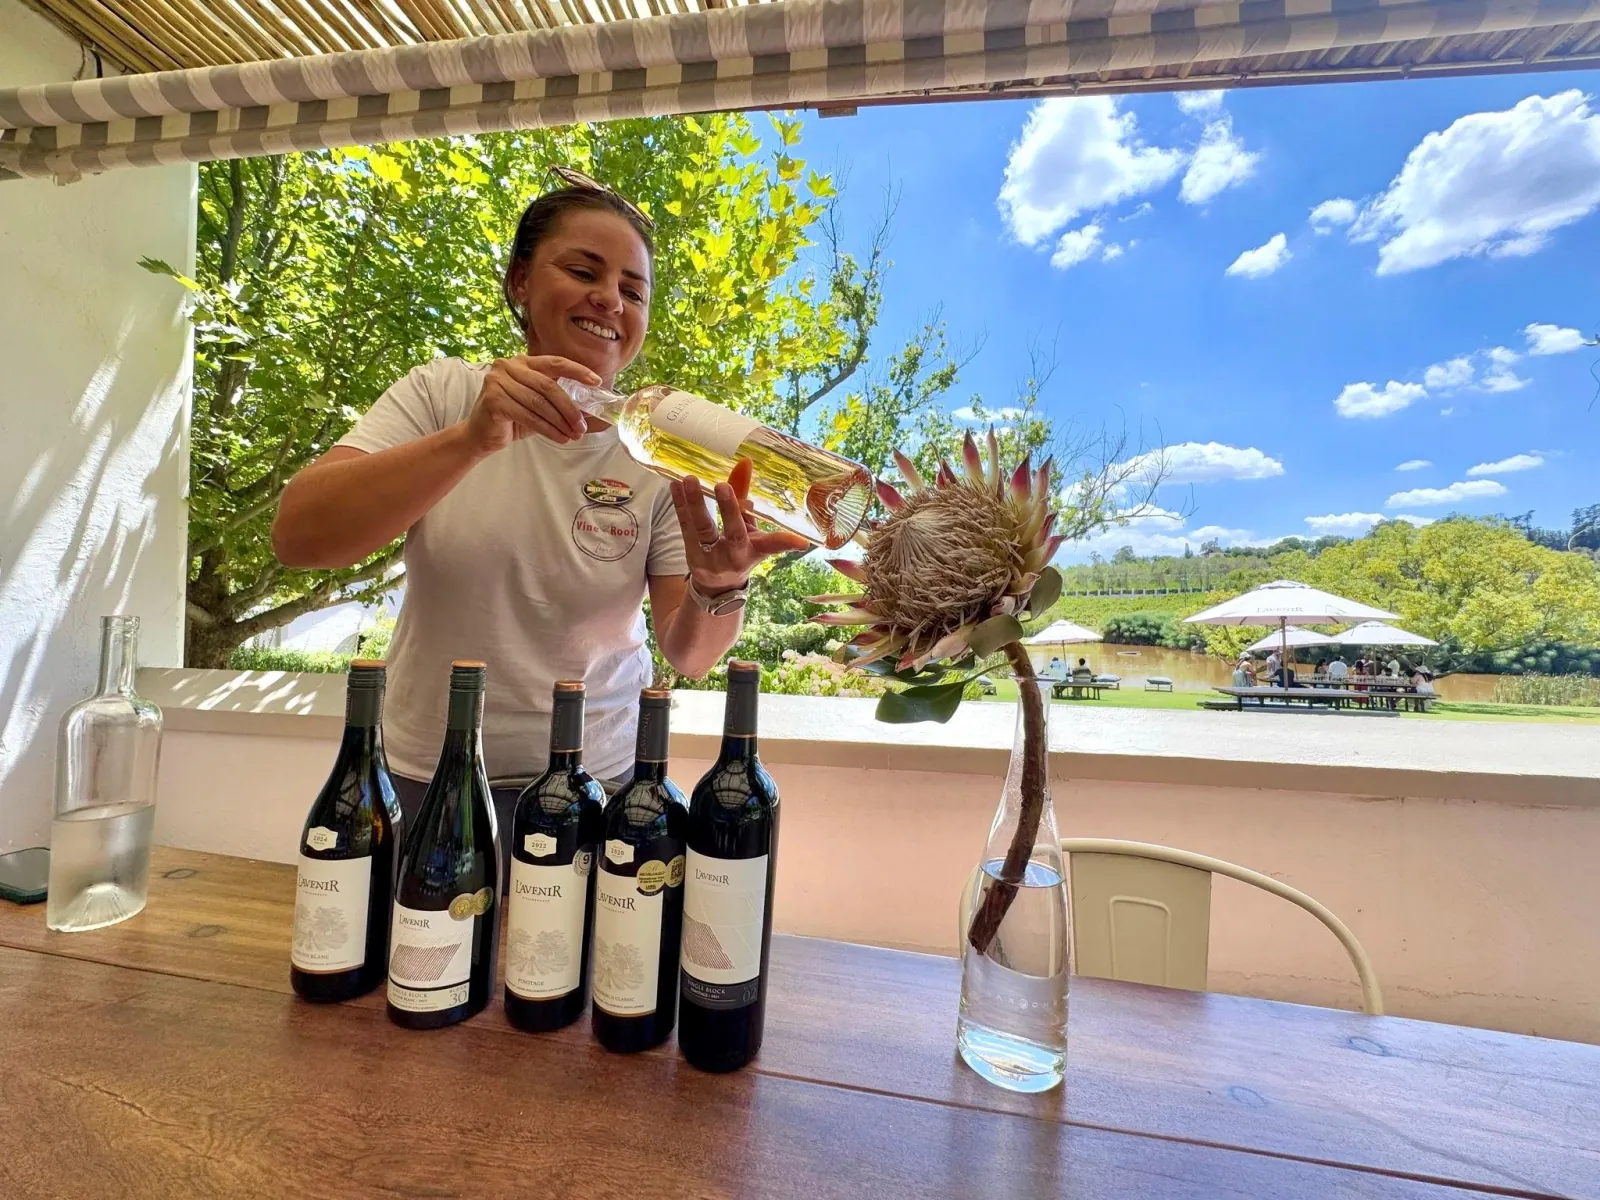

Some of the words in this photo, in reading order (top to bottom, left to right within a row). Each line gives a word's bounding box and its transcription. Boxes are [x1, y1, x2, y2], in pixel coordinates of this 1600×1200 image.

[576, 520, 599, 533] Vine
[610, 525, 635, 538] Root
[313, 834, 328, 843] 2024
[610, 847, 625, 856] 2020
[298, 872, 340, 893] L'AVENIR
[695, 867, 730, 886] L'AVENIR
[515, 878, 563, 898] L'AVENIR
[598, 885, 637, 912] L'AVENIR
[399, 913, 431, 929] L'AVENIR
[517, 977, 545, 987] PINOTAGE
[449, 990, 468, 1006] 30
[705, 986, 726, 995] BLOCK
